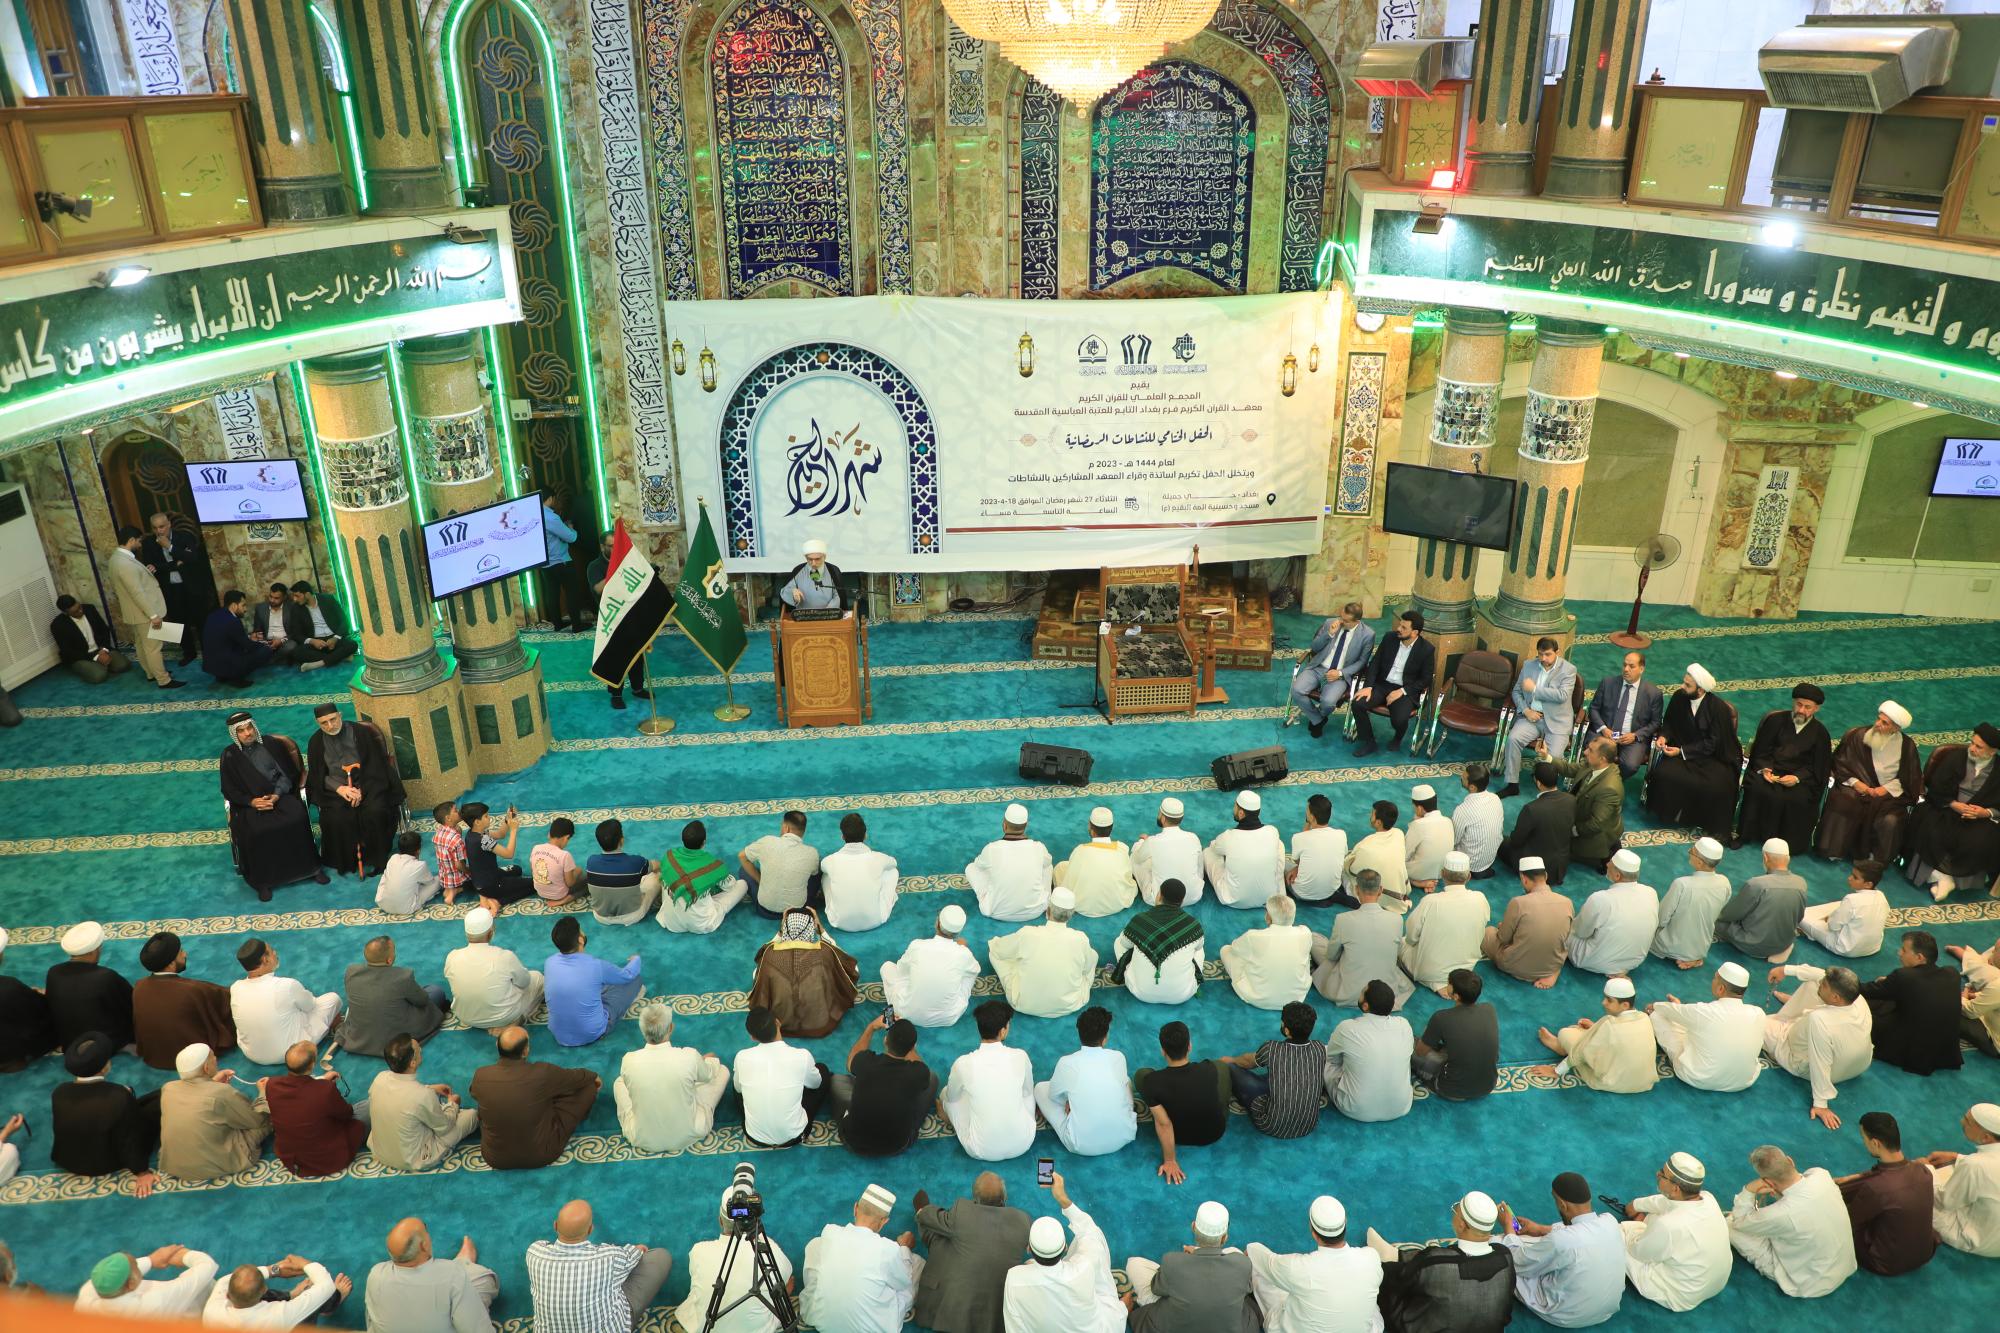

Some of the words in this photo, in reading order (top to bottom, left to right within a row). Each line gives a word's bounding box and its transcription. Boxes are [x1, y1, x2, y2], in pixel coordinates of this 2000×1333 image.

[1484, 254, 1544, 280] العظيم
[1592, 259, 1622, 283] الله
[404, 265, 433, 290] الله
[435, 254, 492, 292] بسم
[1550, 261, 1586, 291] العلي
[353, 267, 400, 304] الرحمن
[1629, 267, 1694, 293] صدق
[286, 273, 350, 311] الرحيم
[1802, 266, 1862, 320] نظرة
[98, 312, 184, 367] يشربون
[64, 342, 95, 376] من
[1130, 380, 1150, 391] يقيم
[1078, 393, 1103, 404] الكريم
[1130, 392, 1167, 403] العلمي
[1168, 391, 1201, 402] المجمع
[1014, 407, 1050, 417] المقدسة
[1051, 406, 1087, 417] العباسية
[1088, 406, 1113, 416] للعتبة
[1114, 404, 1138, 416] التابع
[1140, 404, 1161, 414] بغداد
[1180, 403, 1205, 414] الكريم
[1231, 404, 1263, 412] معهد
[1112, 431, 1156, 445] للنشاطات
[1159, 428, 1187, 446] الختامي
[1188, 424, 1213, 443] الحفل
[1065, 432, 1108, 449] الرمضانية
[1089, 462, 1095, 470] م
[1096, 460, 1117, 468] 2023
[1136, 459, 1156, 467] 1444
[1157, 458, 1175, 469] لعام
[1007, 473, 1051, 483] بالنشاطات
[1052, 472, 1094, 483] المشاركين
[1095, 472, 1125, 481] المعهد
[1178, 470, 1200, 481] تكريم
[1202, 469, 1225, 479] الحفل
[1227, 469, 1255, 479] ويتخلل
[1045, 497, 1067, 505] رمضان
[1067, 497, 1084, 505] شهر
